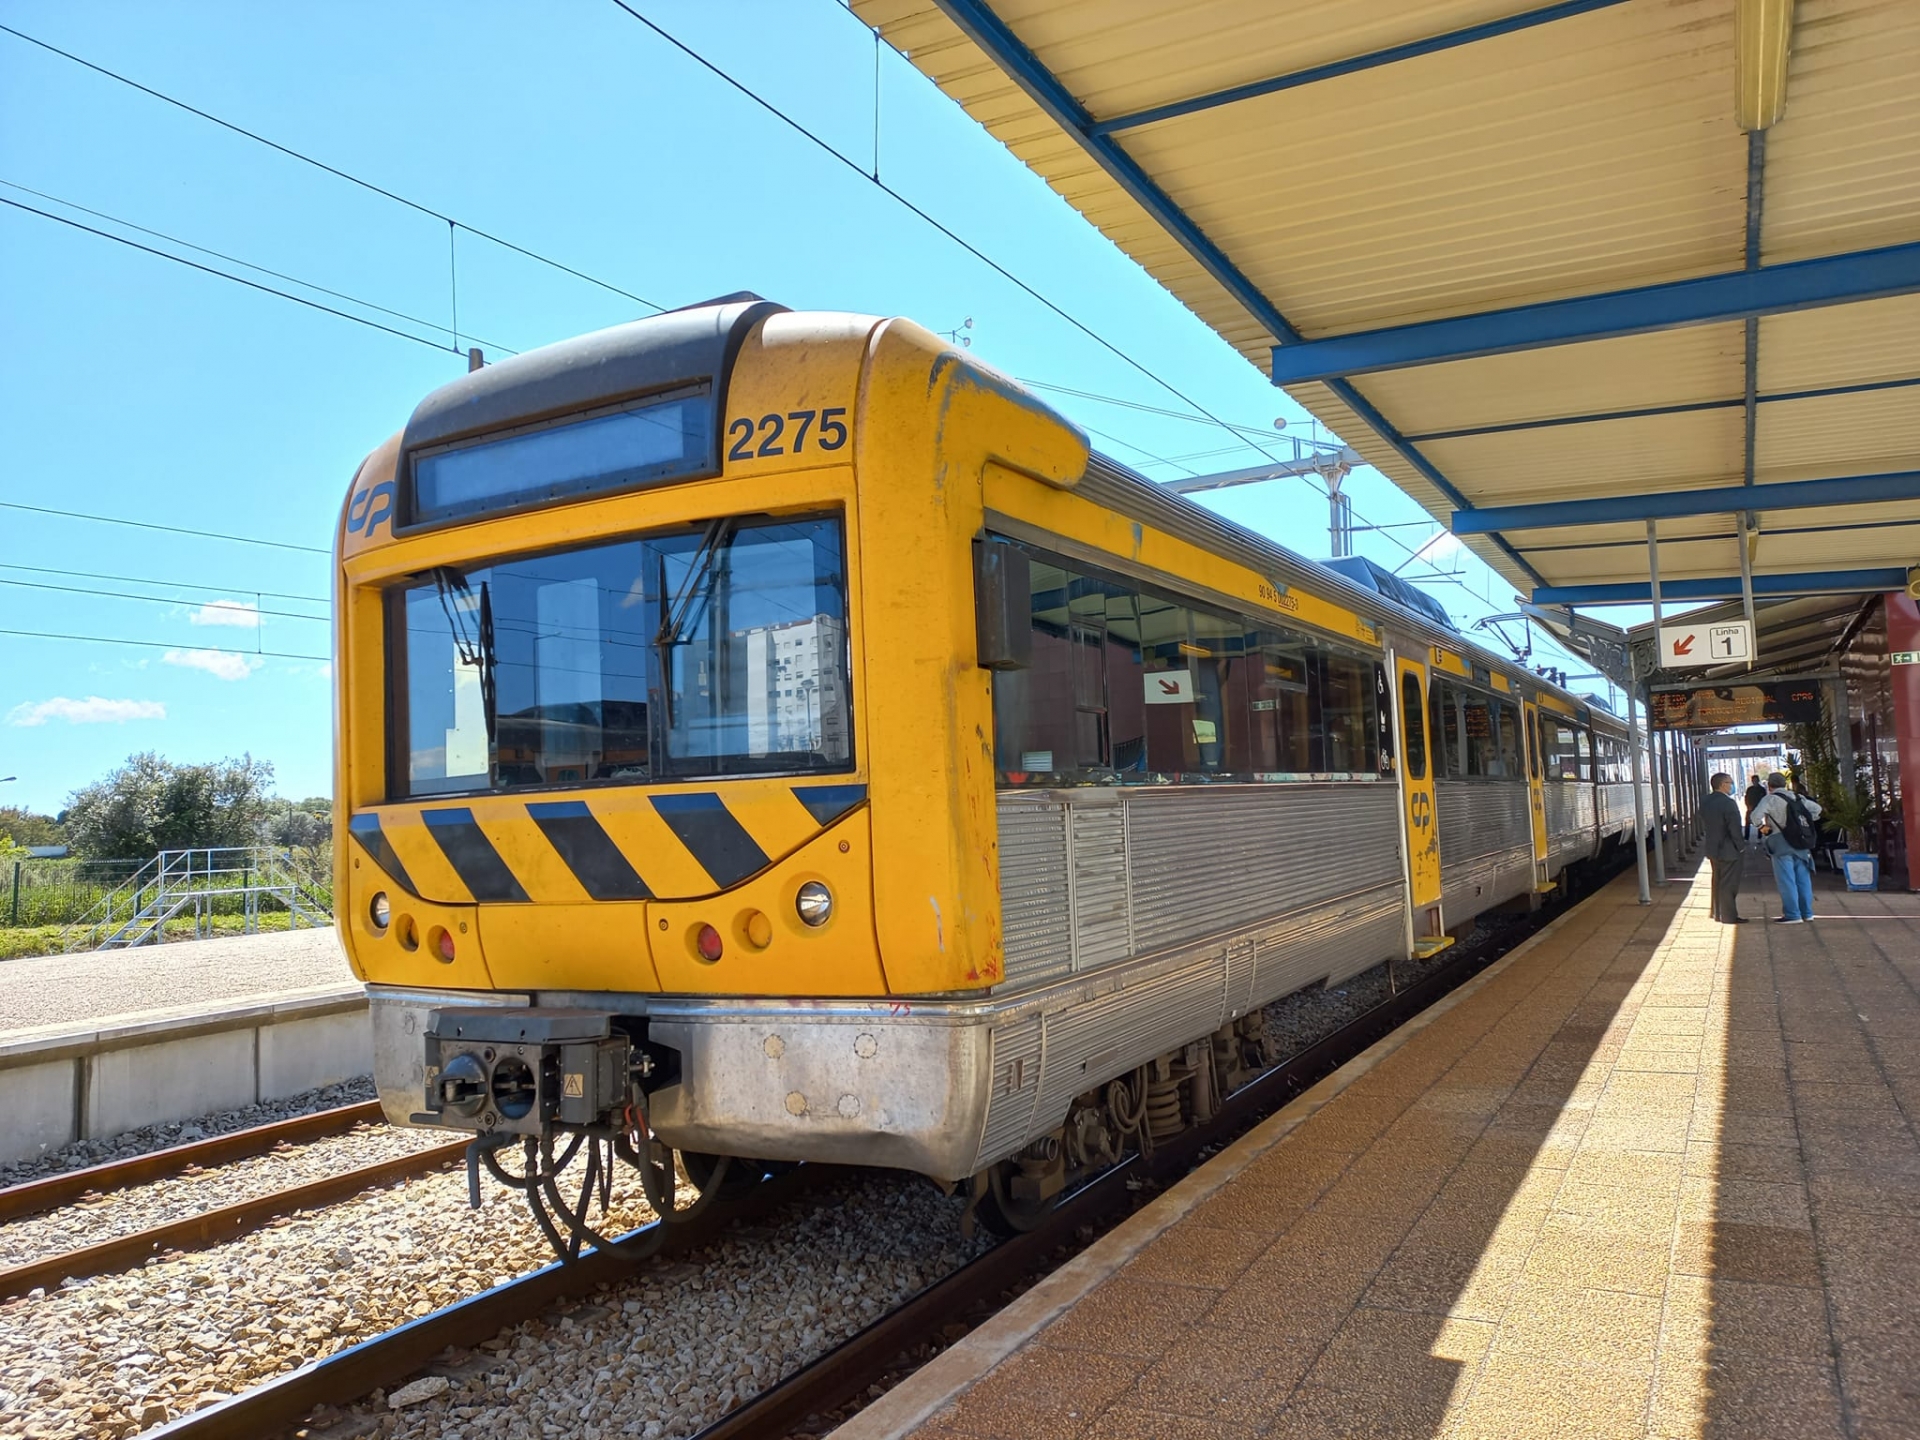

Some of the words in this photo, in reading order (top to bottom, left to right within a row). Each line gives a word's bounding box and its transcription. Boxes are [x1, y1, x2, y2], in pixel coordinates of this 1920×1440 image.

[728, 408, 847, 462] 2275
[348, 480, 394, 538] CP
[1721, 637, 1732, 655] 1
[1411, 792, 1430, 835] CP
